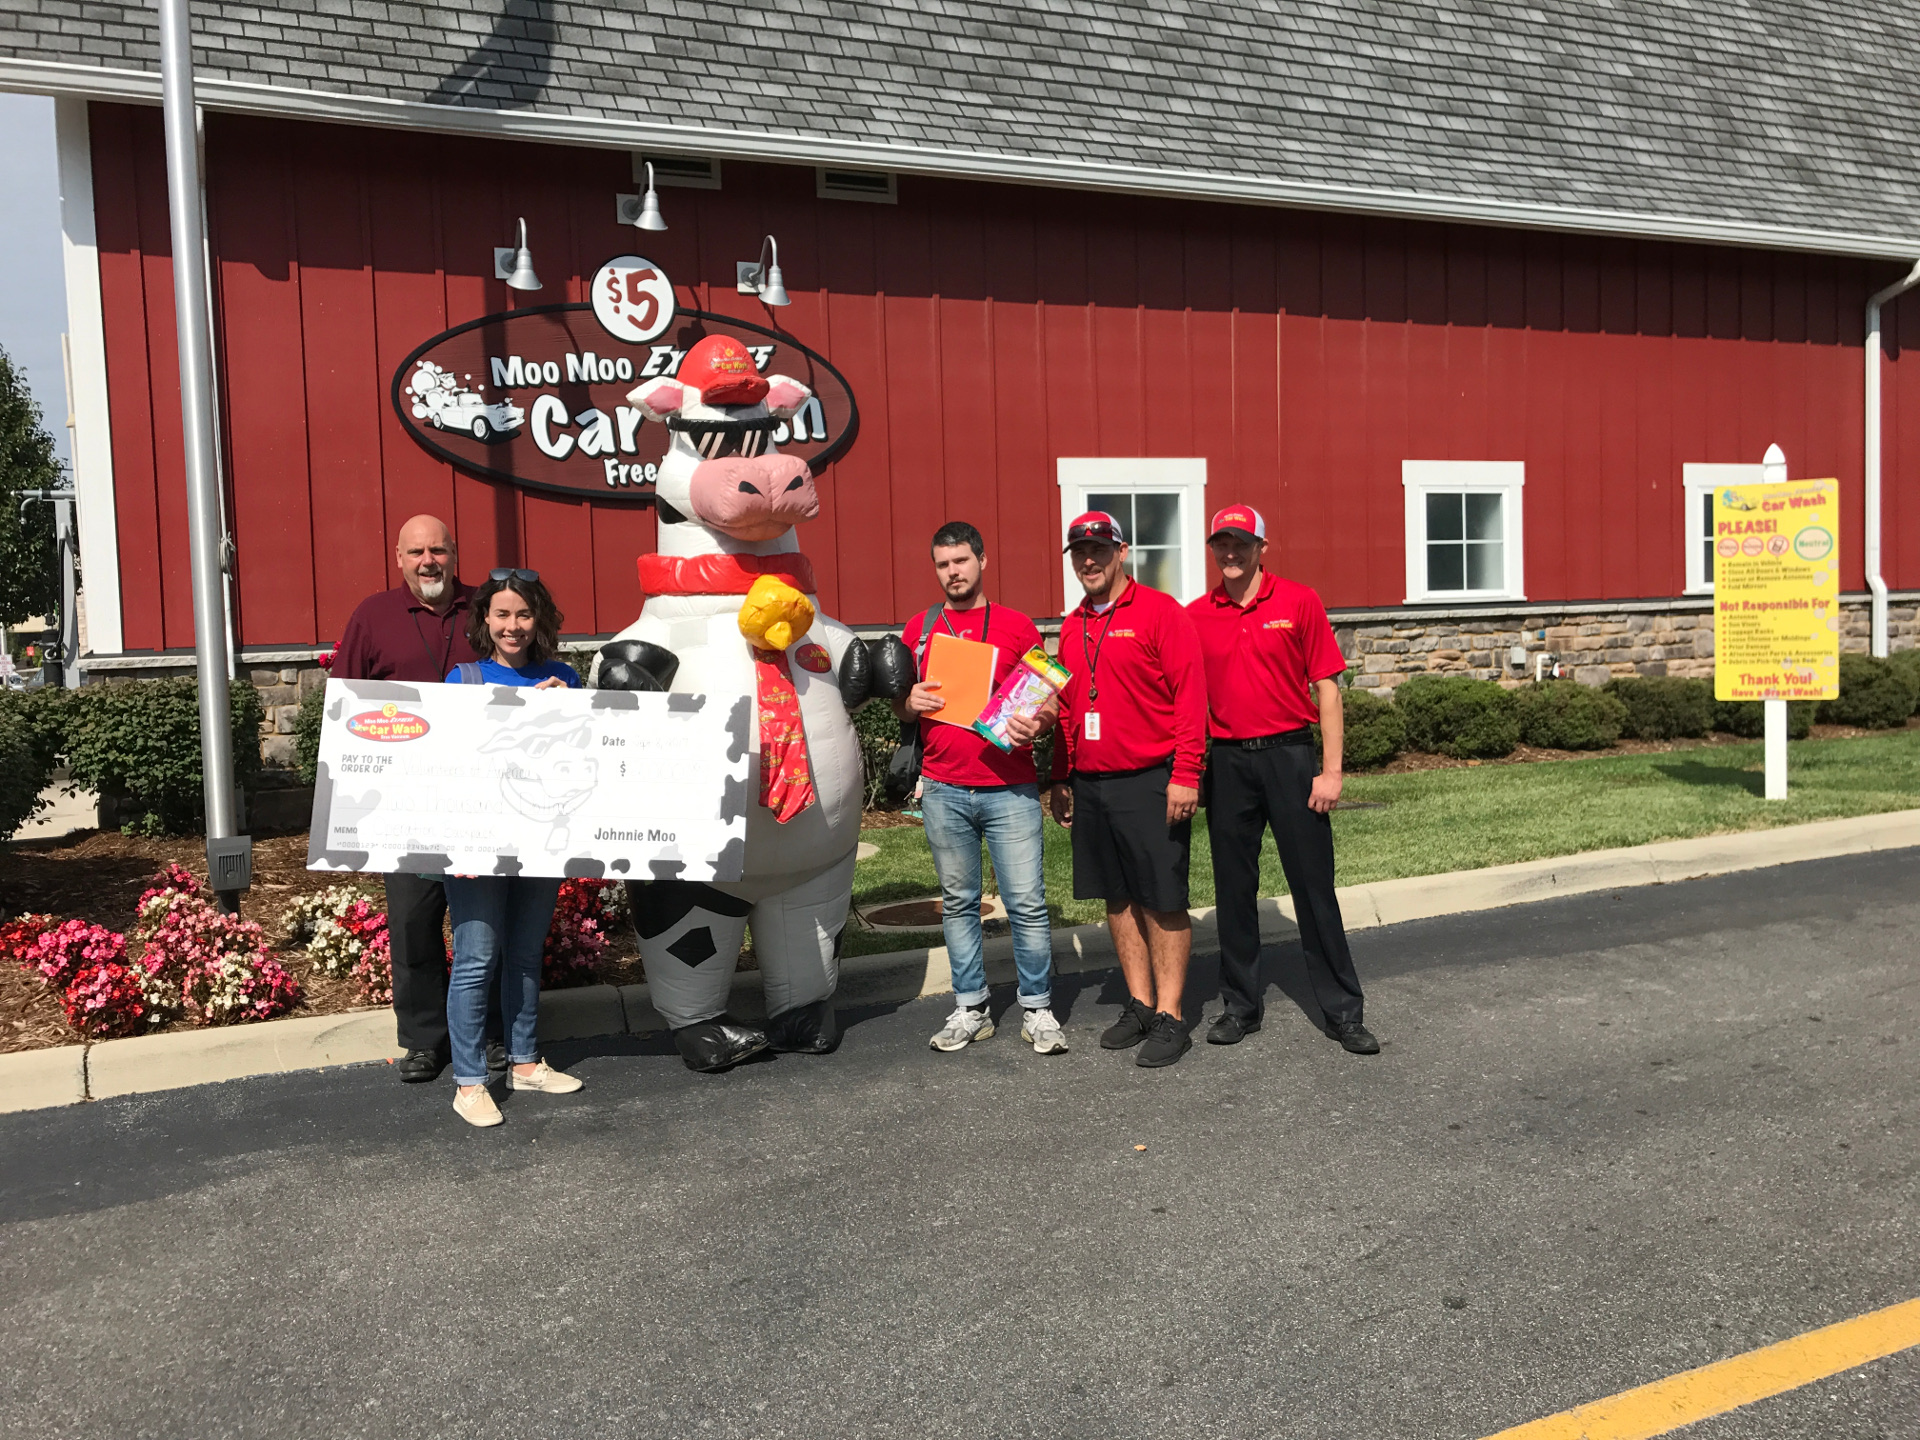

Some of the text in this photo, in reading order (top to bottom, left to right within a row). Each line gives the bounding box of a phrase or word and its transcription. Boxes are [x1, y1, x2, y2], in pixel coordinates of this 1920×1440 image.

[606, 268, 659, 331] $5
[490, 355, 560, 387] Moo
[565, 351, 633, 383] Moo
[531, 393, 642, 458] Car
[603, 458, 657, 486] Free
[1762, 501, 1785, 512] Car
[1789, 493, 1826, 509] Wash
[1718, 519, 1777, 536] PLEASE!
[1798, 539, 1829, 548] Neutral
[1720, 598, 1830, 613] Not Responsible For
[1739, 672, 1812, 685] Thank You!
[1731, 688, 1754, 697] Have
[1764, 688, 1791, 697] Great
[1793, 687, 1823, 697] Wash!
[369, 722, 423, 735] Car Wash
[602, 735, 626, 747] Date
[341, 754, 393, 765] PAY TO THE
[341, 763, 385, 774] ORDER OF
[620, 760, 627, 777] $
[334, 826, 358, 834] MEMO
[594, 827, 676, 842] Johnnie Moo
